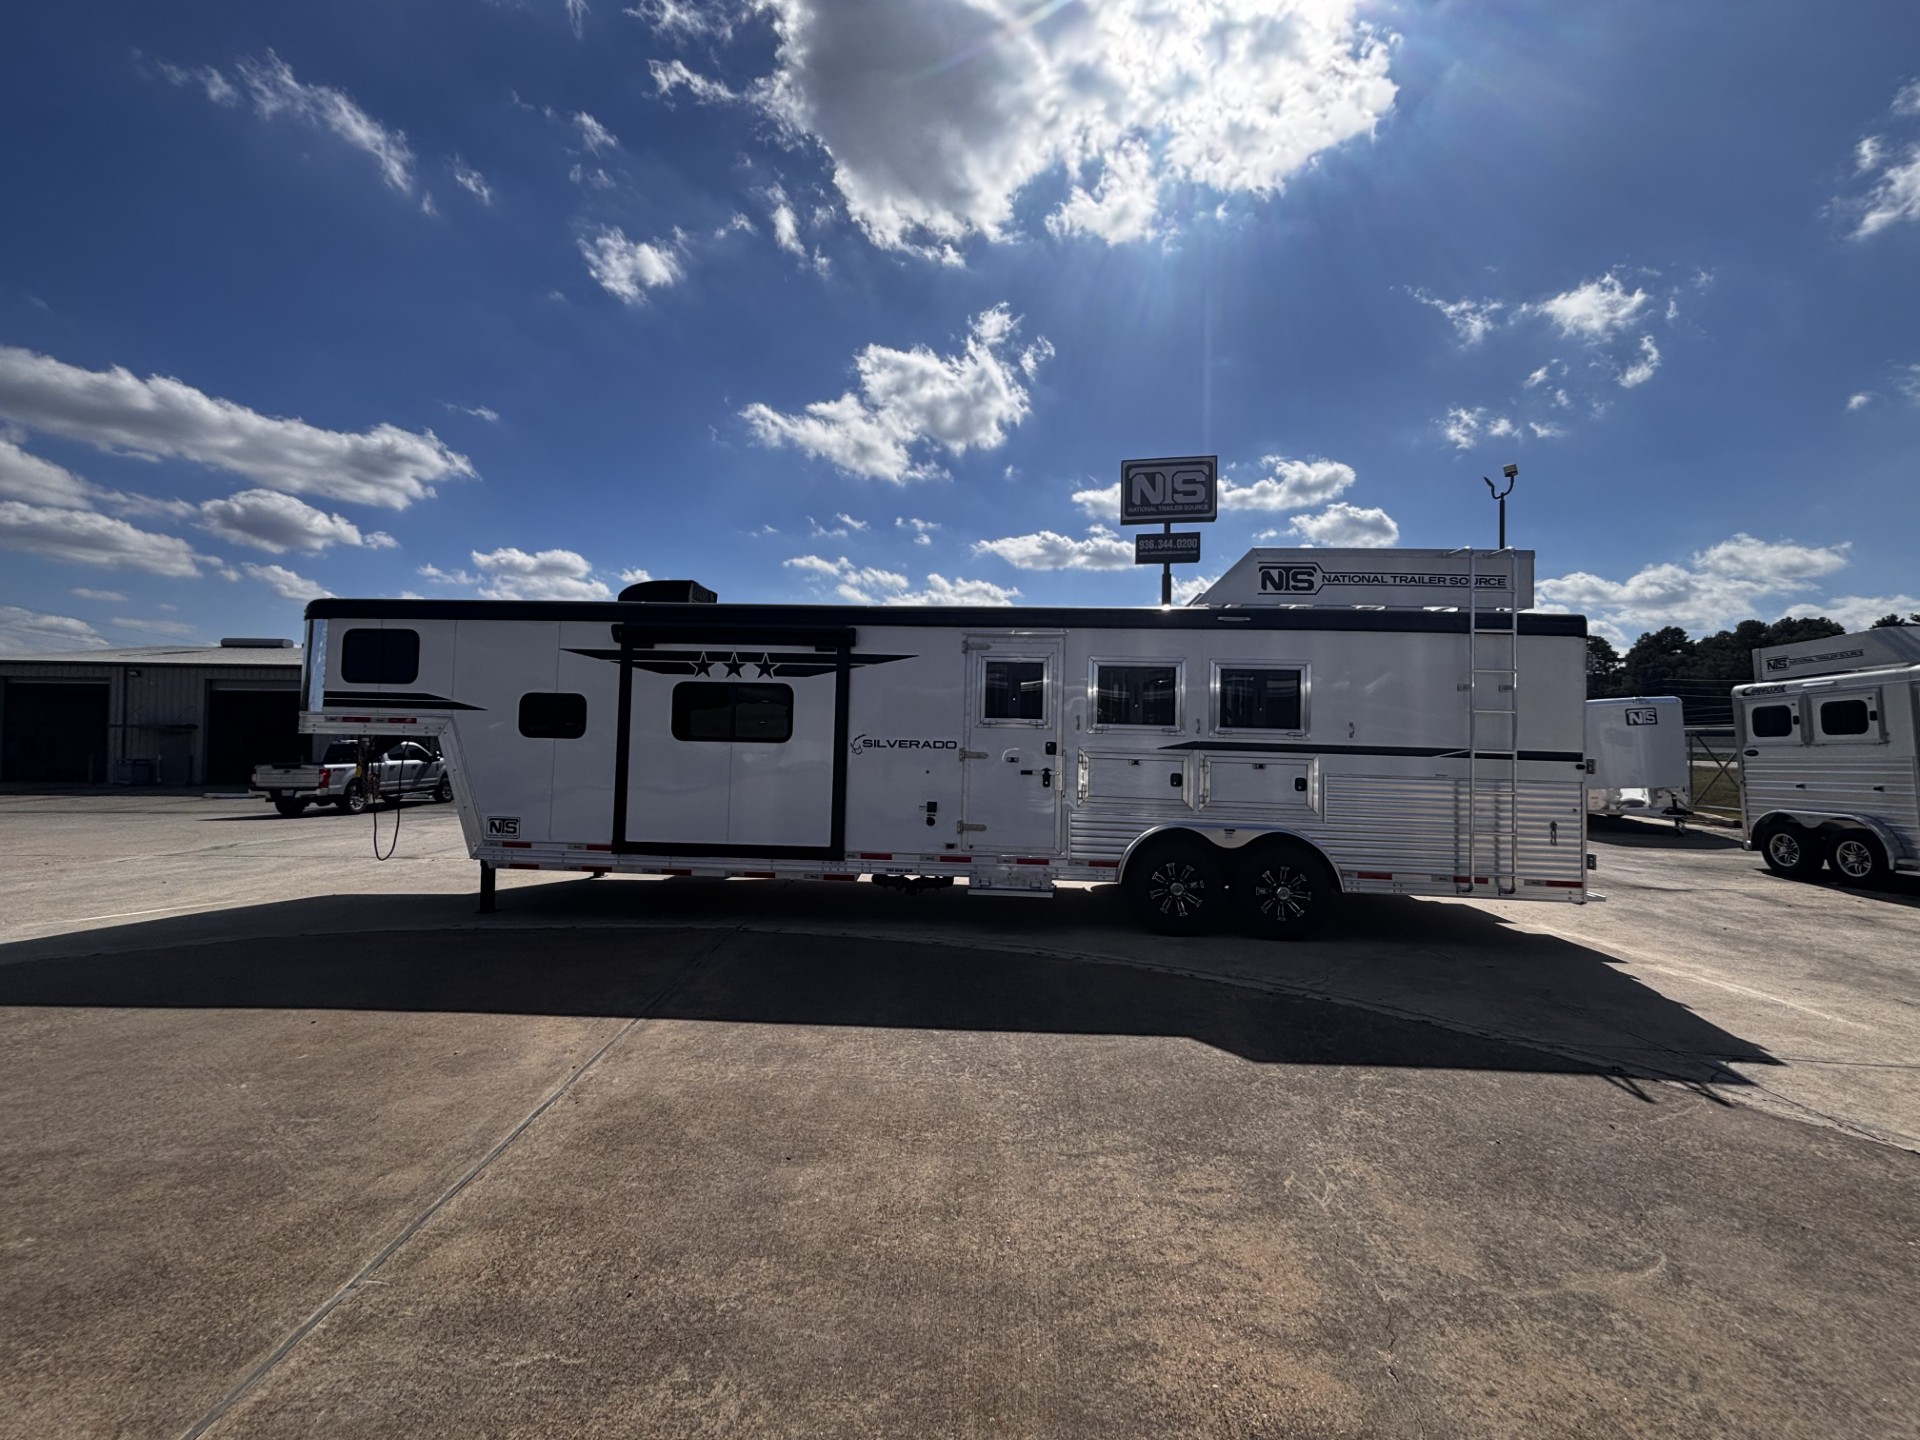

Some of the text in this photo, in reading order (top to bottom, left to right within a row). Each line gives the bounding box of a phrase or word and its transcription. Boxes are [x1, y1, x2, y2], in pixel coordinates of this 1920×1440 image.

[1158, 504, 1183, 512] TRAILER
[1184, 503, 1209, 511] SOURCE
[1138, 538, 1198, 550] 936.344.0200
[1259, 565, 1317, 591] NTS
[1321, 574, 1388, 584] NATIONAL
[1390, 575, 1447, 585] TRAILER
[862, 739, 958, 750] SILVERADO
[488, 817, 519, 834] NTS
